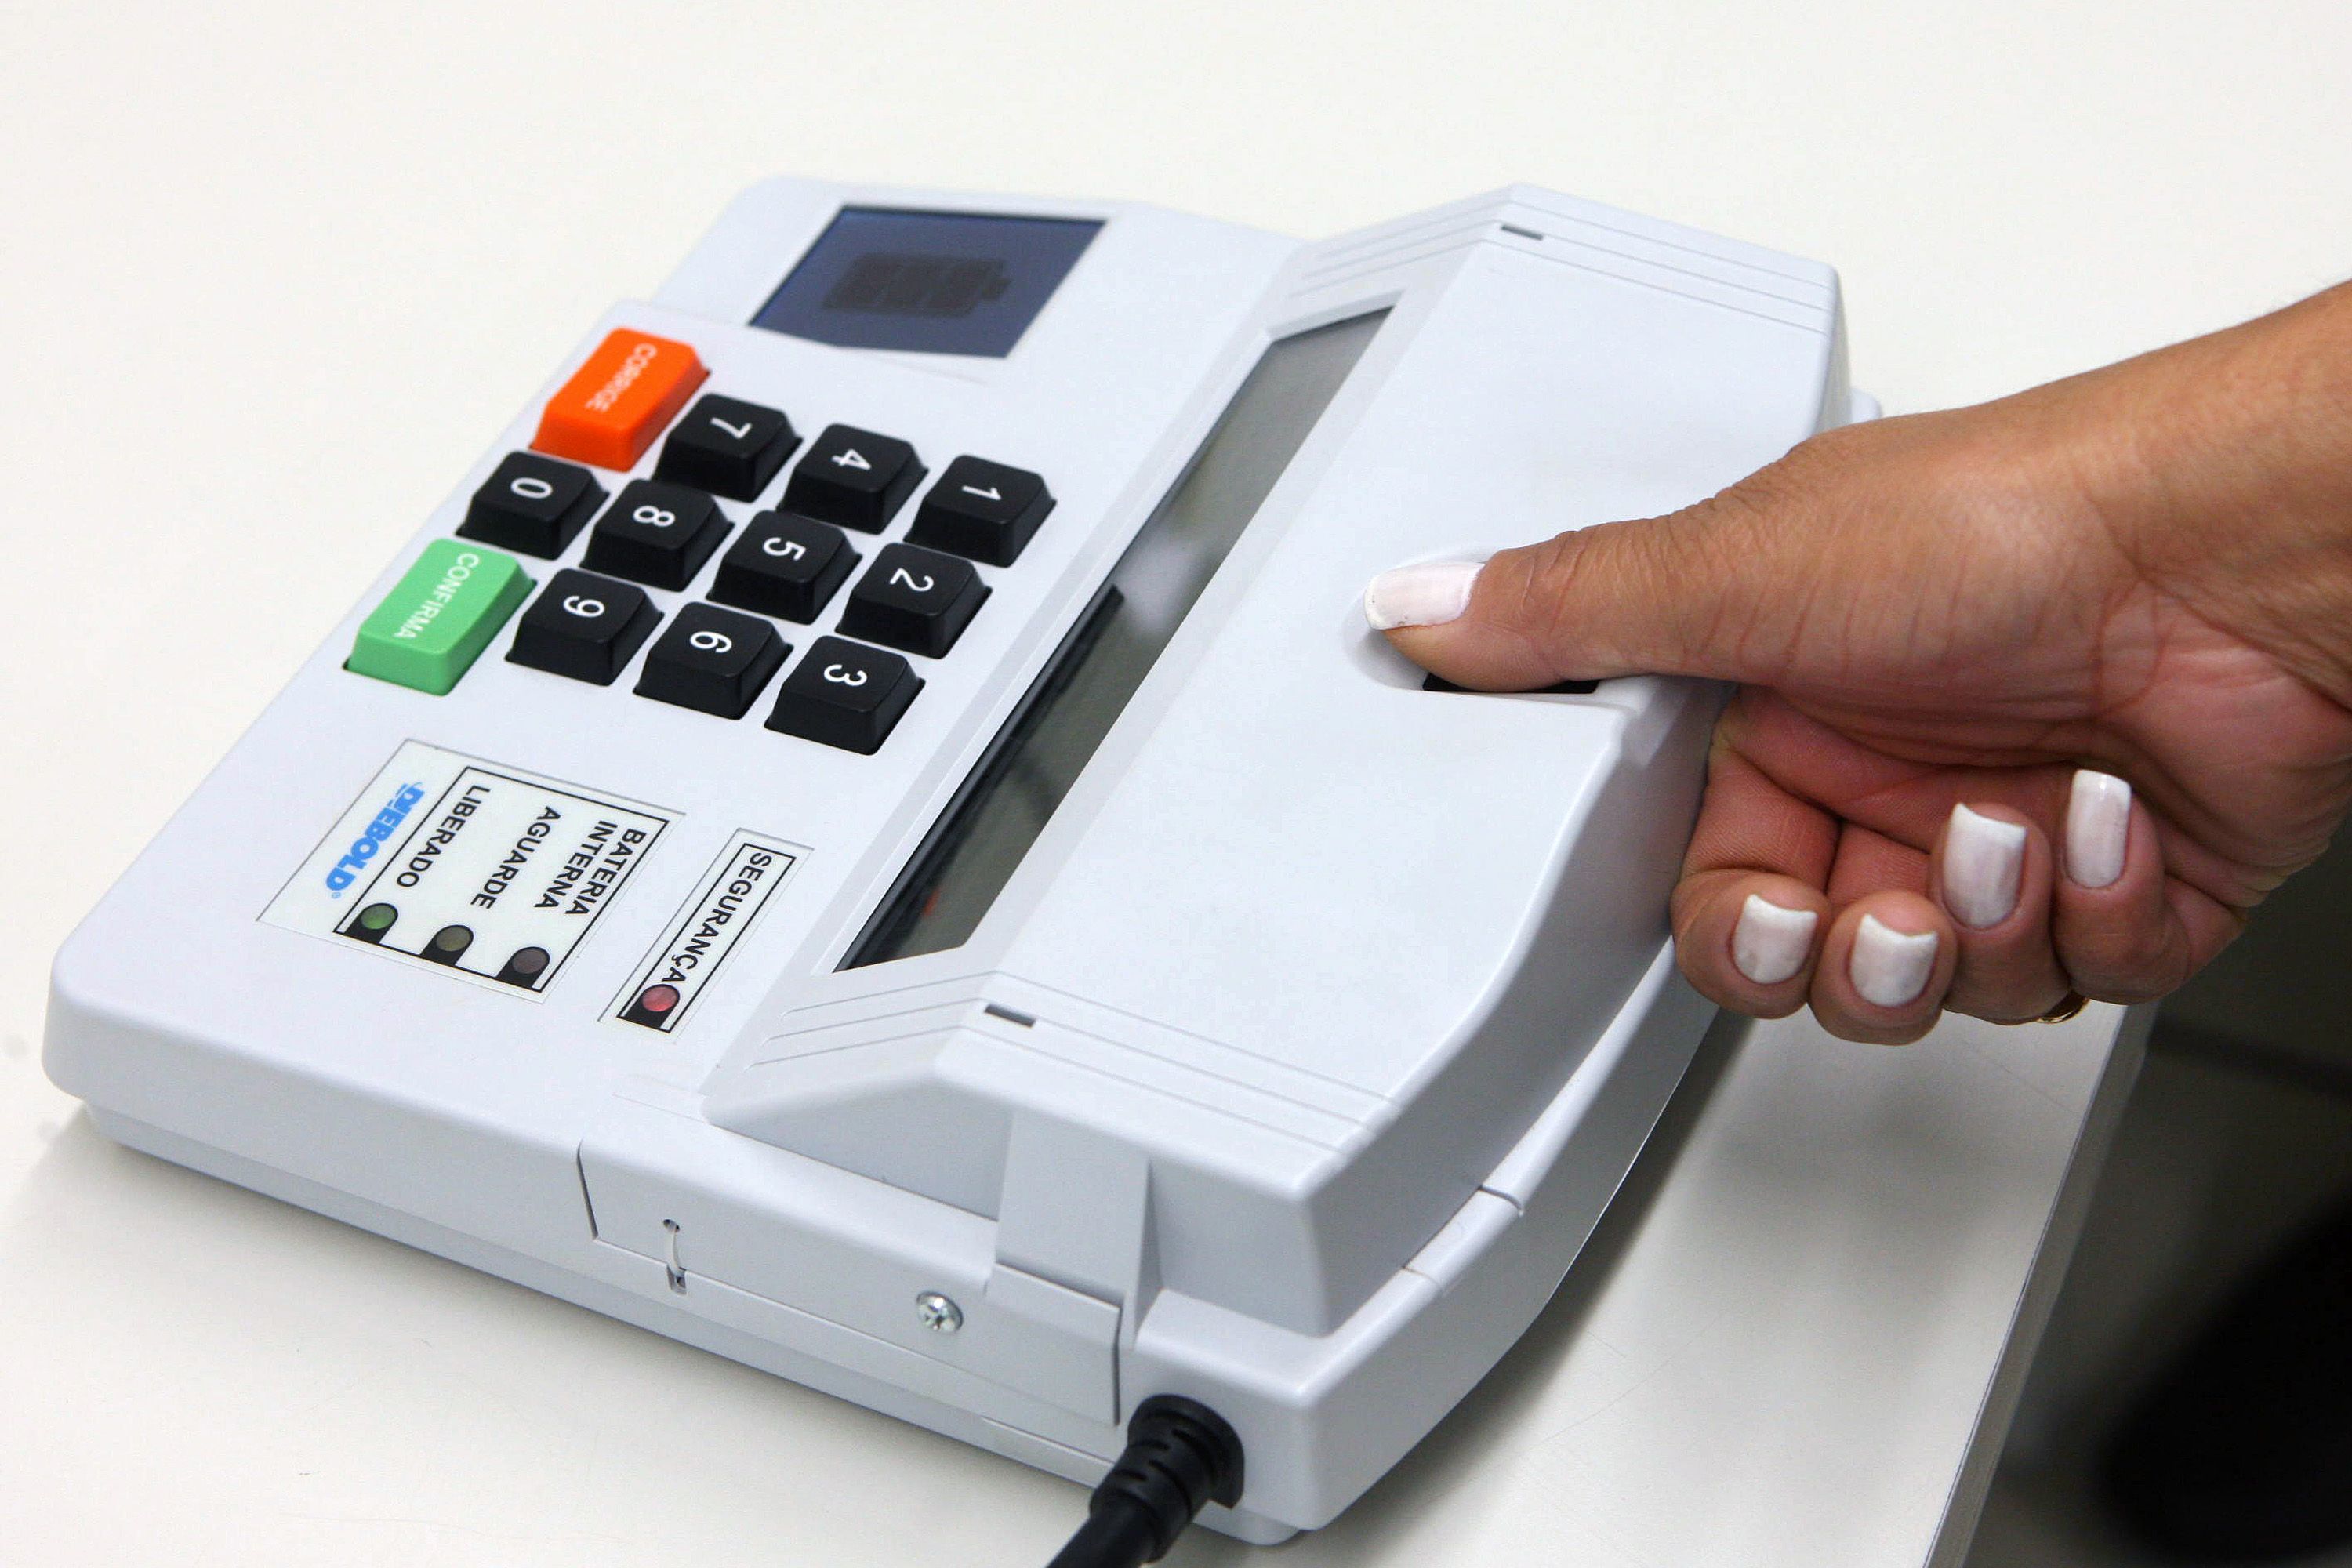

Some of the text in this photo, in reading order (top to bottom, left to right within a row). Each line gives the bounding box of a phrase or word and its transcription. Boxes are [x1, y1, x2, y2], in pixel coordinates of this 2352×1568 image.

[585, 343, 657, 412] CORRIGE
[711, 417, 752, 439] 7
[831, 449, 871, 470] 4
[511, 477, 553, 499] 0
[962, 485, 1002, 501] 1
[633, 505, 675, 527] 8
[763, 537, 805, 561] 5
[890, 568, 934, 592] 2
[394, 553, 480, 639] CONFIRMA
[563, 595, 604, 618] 9
[690, 631, 732, 653] 6
[824, 664, 867, 686] 3
[397, 785, 490, 887] LIBERADO
[470, 806, 561, 909] AGUARDE
[535, 820, 618, 909] INTERNA
[564, 828, 648, 915] BATERIA
[662, 852, 772, 982] SEGURANÇA
